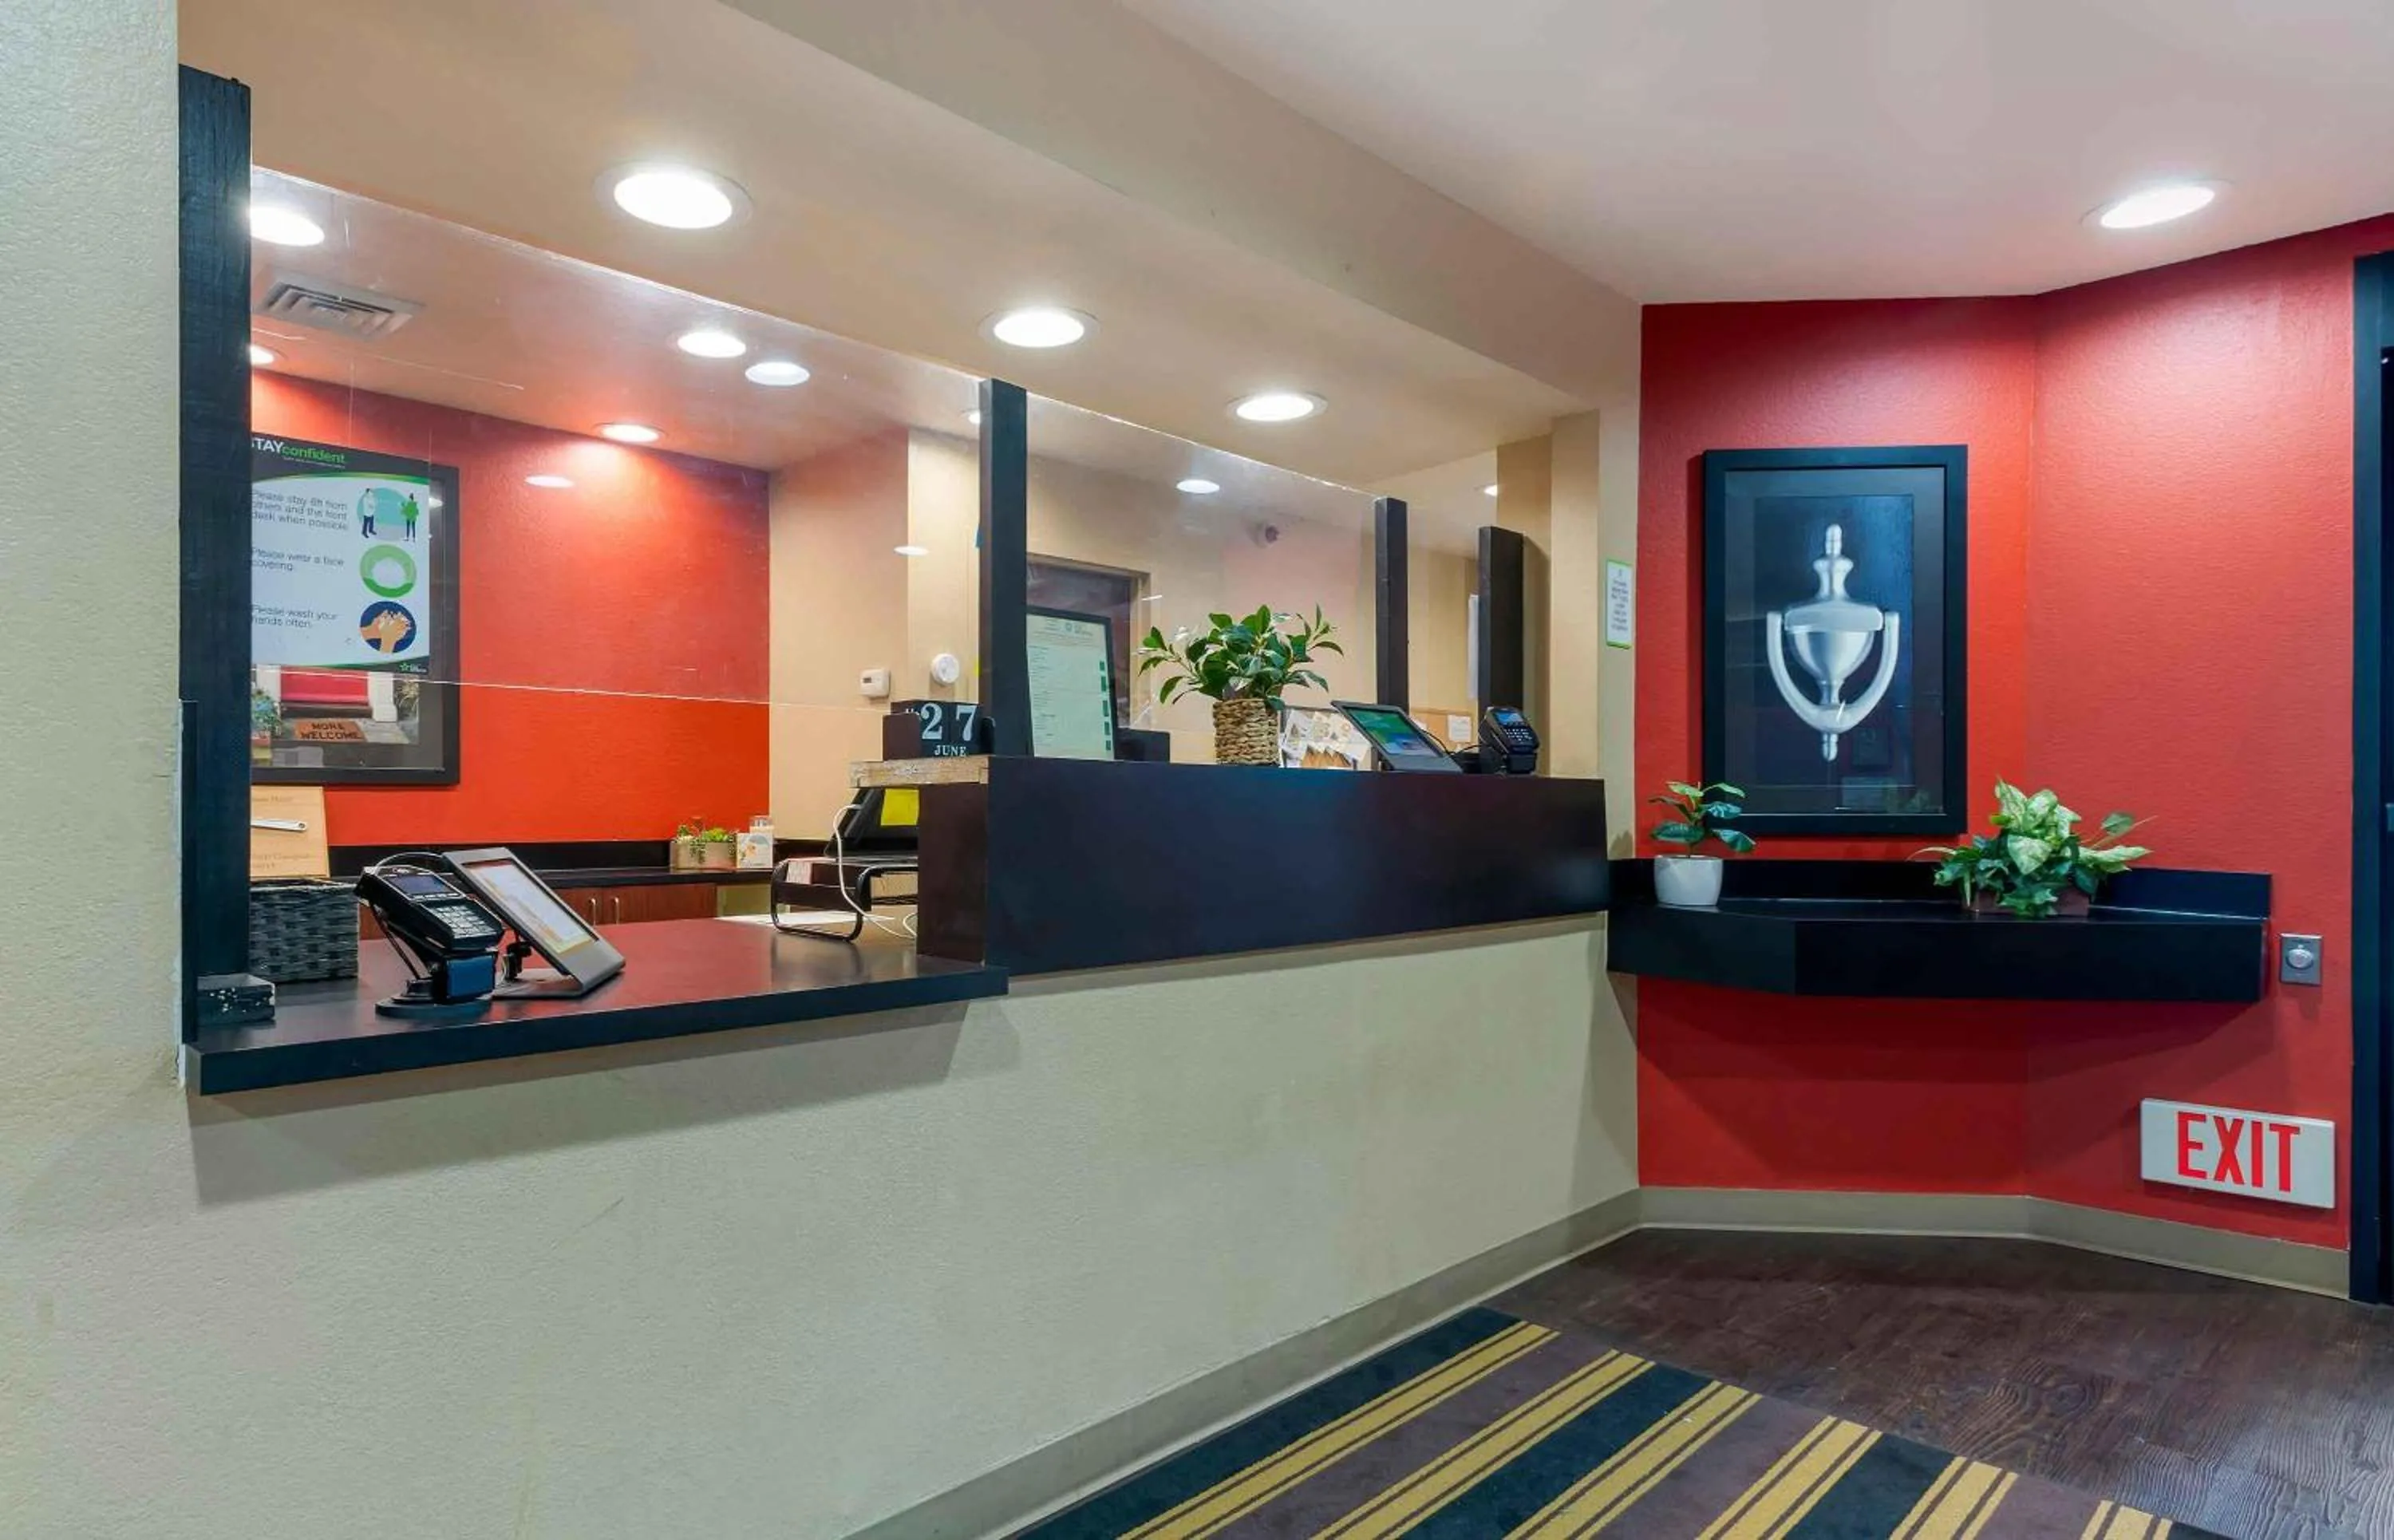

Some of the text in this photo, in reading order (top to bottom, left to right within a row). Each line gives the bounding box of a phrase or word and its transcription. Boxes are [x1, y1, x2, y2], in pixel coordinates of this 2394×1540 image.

[285, 505, 304, 515] and
[934, 744, 966, 757] JUNE
[2178, 1111, 2301, 1193] EXIT
